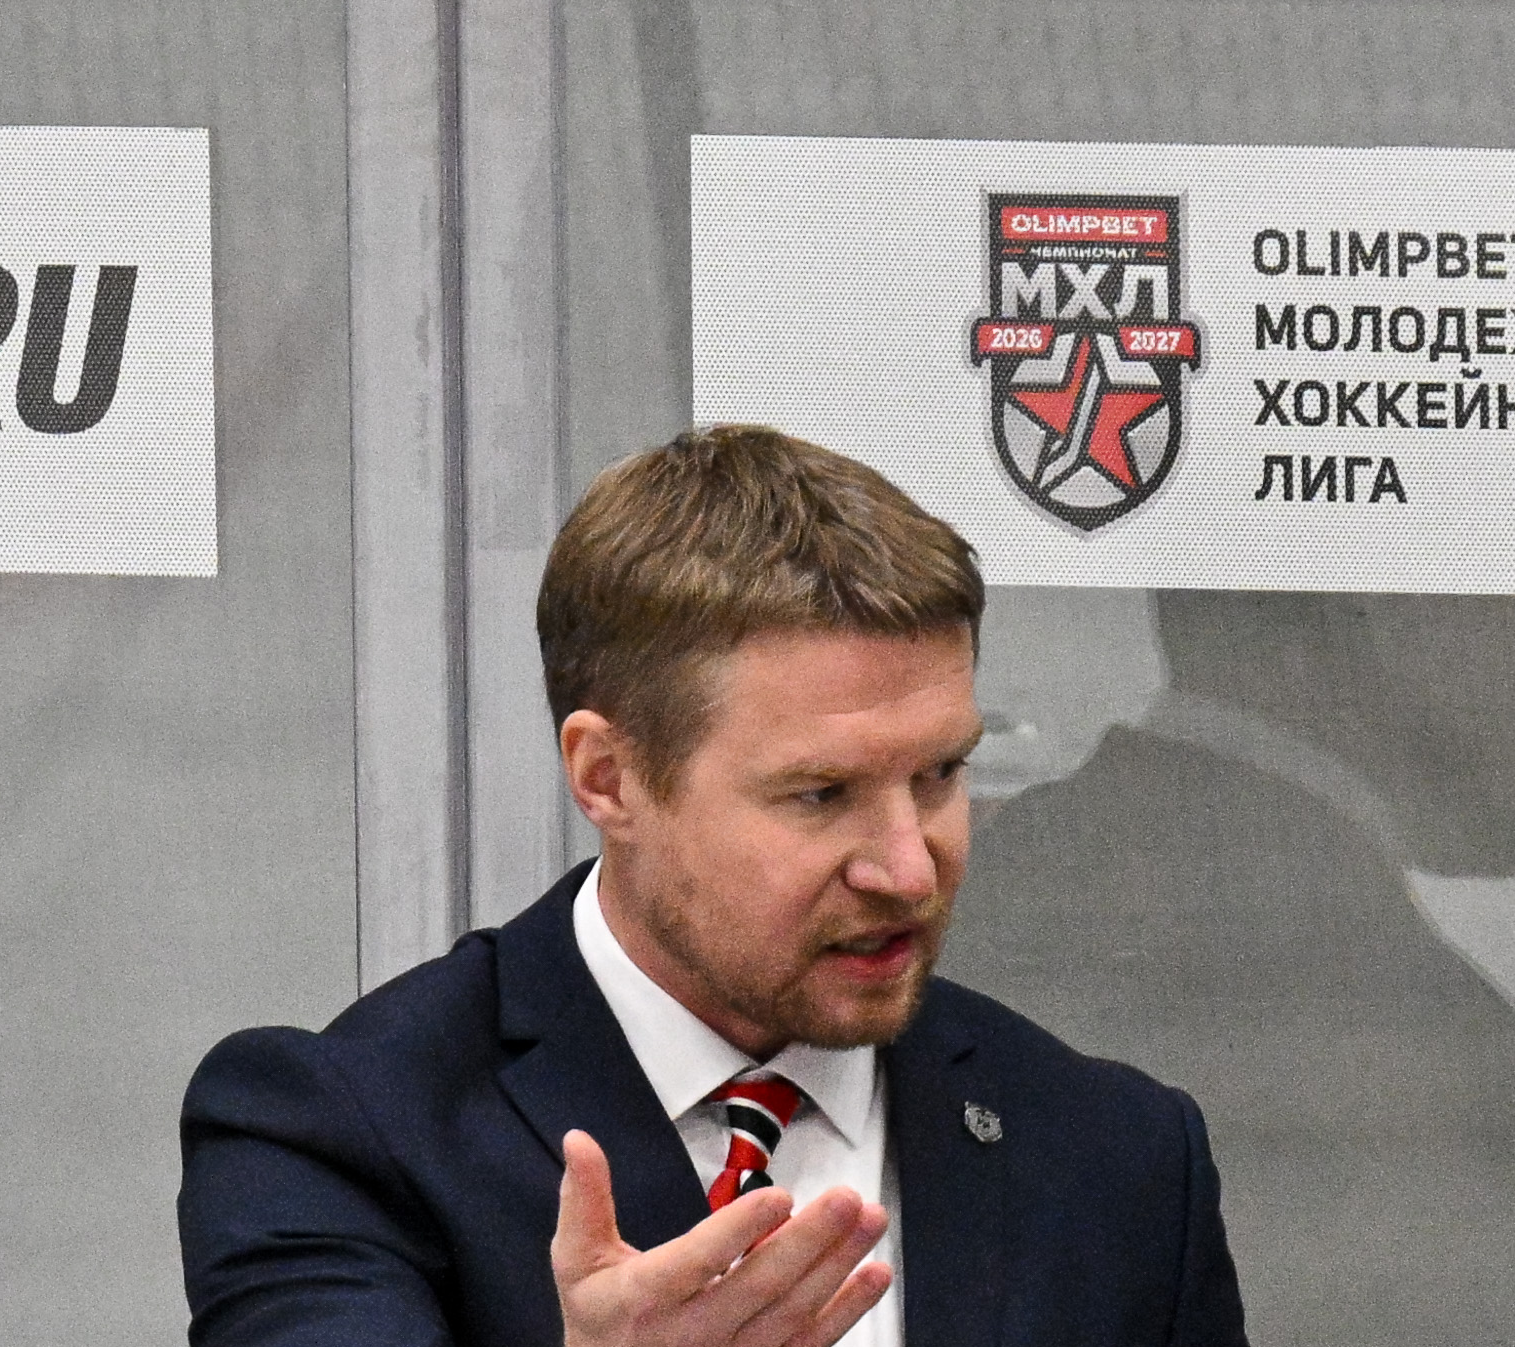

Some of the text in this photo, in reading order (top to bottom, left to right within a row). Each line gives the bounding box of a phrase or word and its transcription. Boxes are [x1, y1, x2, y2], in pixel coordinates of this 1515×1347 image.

[1011, 213, 1158, 235] OLIMPBET
[1000, 262, 1170, 320] МХЛ
[990, 328, 1043, 349] 2026
[1129, 331, 1182, 351] 2027
[1254, 455, 1408, 504] ЛИГА
